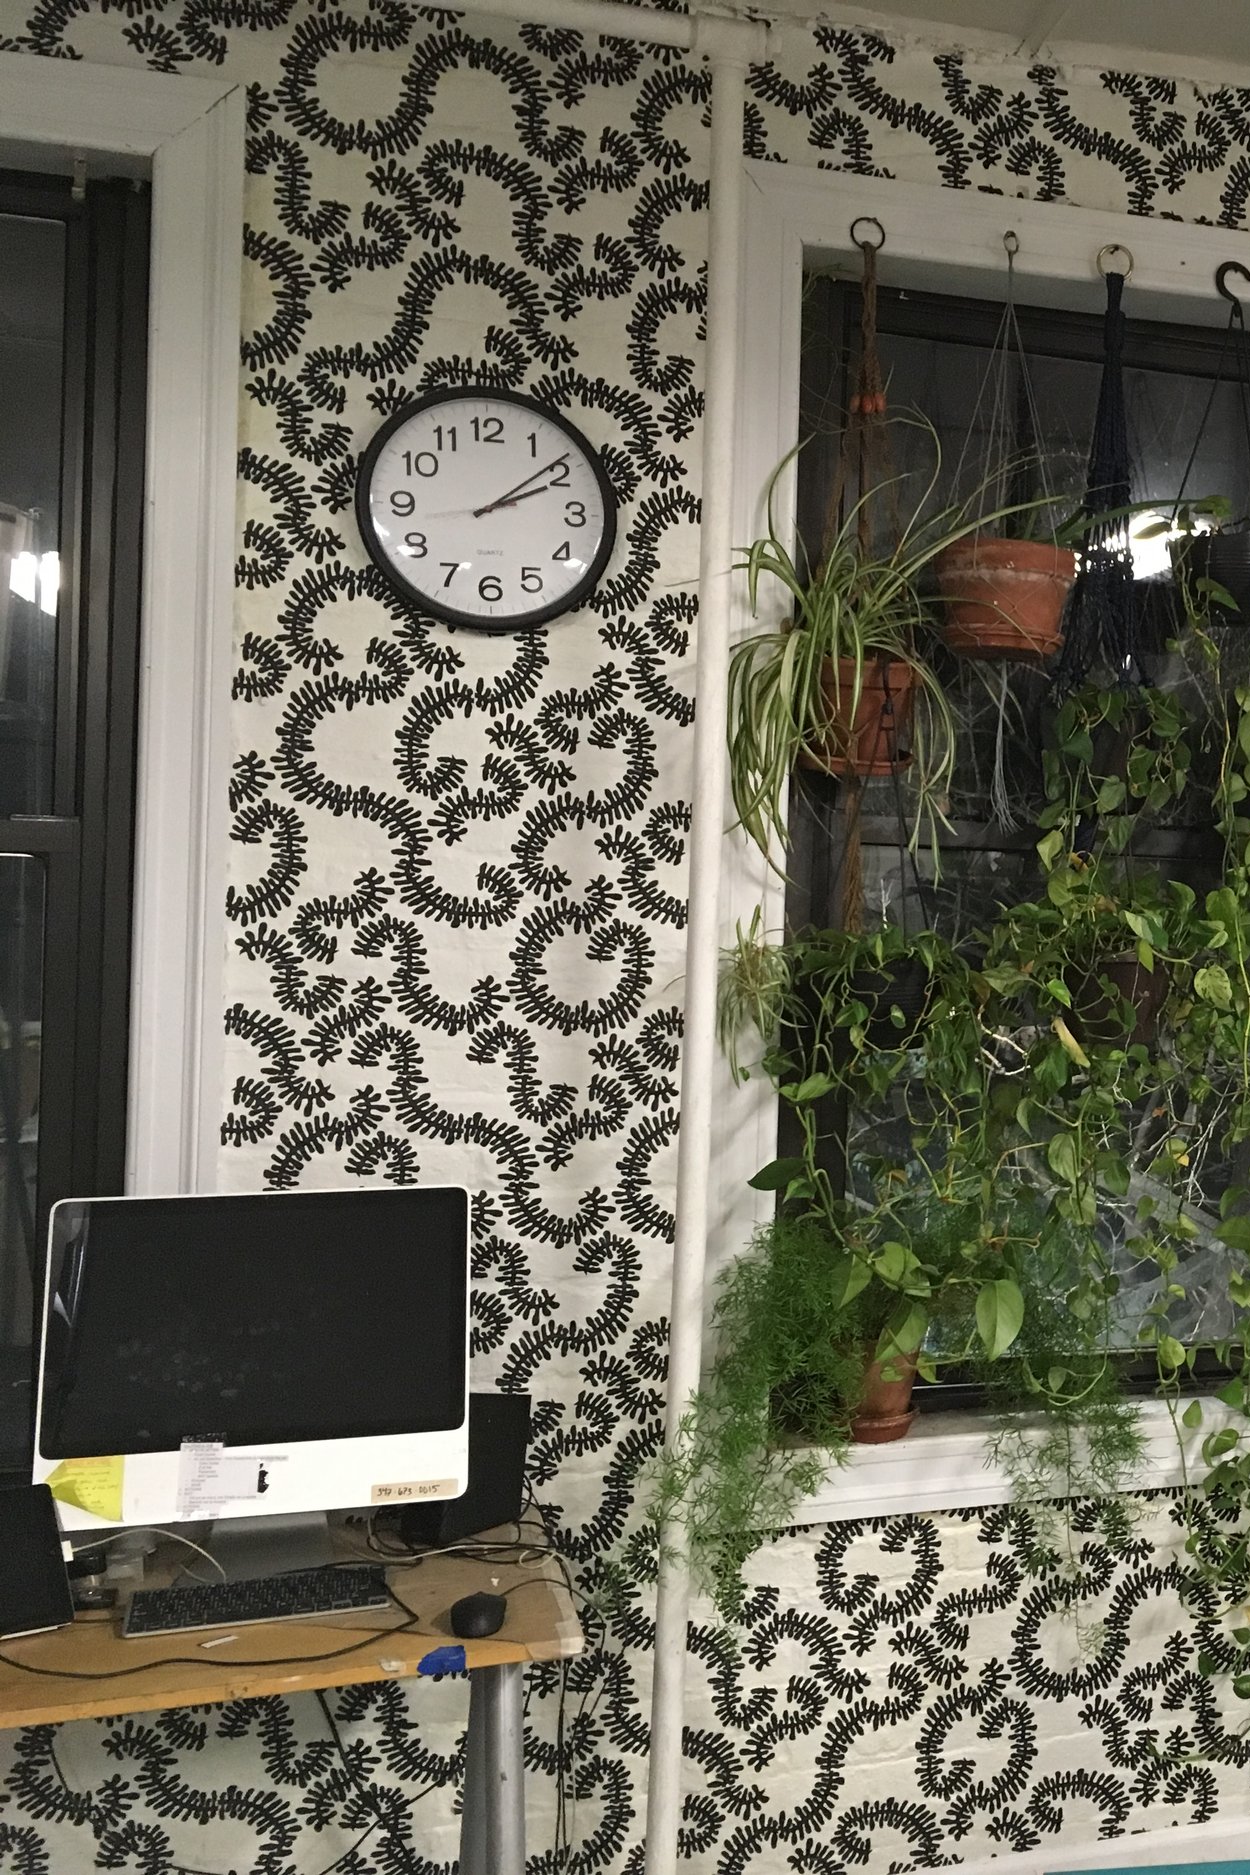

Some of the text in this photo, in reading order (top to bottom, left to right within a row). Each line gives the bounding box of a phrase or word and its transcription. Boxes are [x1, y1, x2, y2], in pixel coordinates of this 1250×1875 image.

[433, 425, 457, 452] 11
[470, 416, 505, 444] 12
[526, 432, 537, 458] 1
[401, 450, 439, 478] 10
[549, 460, 571, 488] 2
[390, 490, 416, 517] 9
[564, 501, 587, 528] 3
[403, 532, 428, 559] 8
[551, 541, 571, 564] 4
[439, 562, 460, 588] 7
[477, 575, 504, 602] 6
[520, 566, 544, 594] 5
